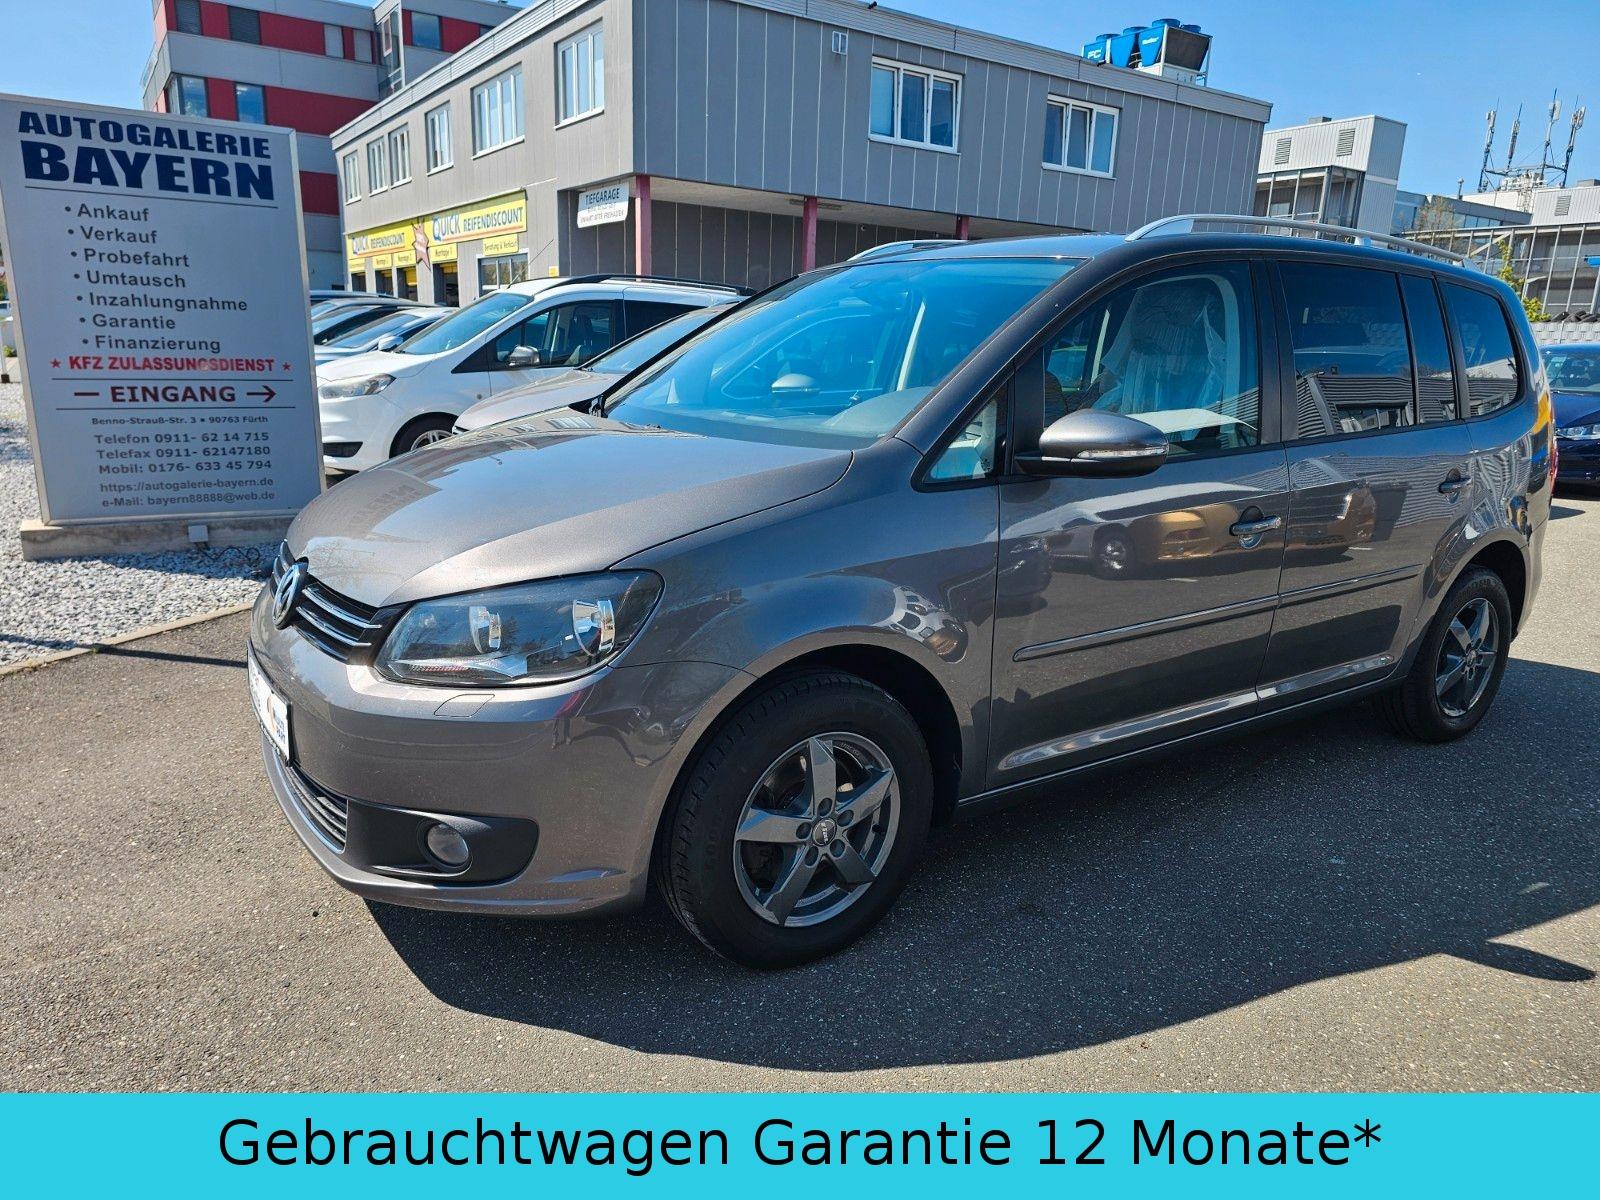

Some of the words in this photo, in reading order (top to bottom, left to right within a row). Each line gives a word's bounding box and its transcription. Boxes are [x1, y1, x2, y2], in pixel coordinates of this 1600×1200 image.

[18, 111, 271, 159] AUTOGALERIE
[20, 140, 275, 200] BAYERN
[585, 187, 620, 206] TIEFGARAGE
[77, 203, 150, 222] Ankauf
[432, 214, 461, 241] QUICK
[463, 206, 524, 232] REIFENDISCOUNT
[80, 226, 158, 244] Verkauf
[352, 235, 370, 256] QUICK
[84, 249, 190, 268] Probefahrt
[86, 270, 186, 288] Umtausch
[89, 292, 248, 313] Inzahlungnahme
[92, 313, 176, 330] Garantie
[95, 335, 221, 354] Finanzierung
[69, 356, 104, 370] KFZ
[108, 356, 275, 371] ZULASSUNGSDIENST
[110, 385, 237, 403] EINGANG
[91, 417, 188, 425] Benno-Strauß-Str.
[190, 416, 197, 424] 3
[208, 415, 240, 424] 90763
[242, 415, 268, 423] Fürth
[94, 433, 150, 444] Telefon
[154, 433, 197, 443] 0911-
[201, 432, 218, 442] 62
[223, 432, 240, 442] 14
[244, 431, 270, 441] 715
[96, 449, 151, 459] Telefax
[156, 448, 197, 458] 0911-
[202, 446, 271, 457] 62147180
[99, 463, 144, 474] Mobil:
[148, 463, 191, 473] 0176-
[195, 461, 221, 471] 633
[226, 461, 243, 470] 45
[247, 460, 272, 470] 794
[100, 477, 274, 493] https://autogalerie-bayern.de
[102, 496, 144, 507] e-Mail:
[147, 491, 275, 506] bayern88888@web.de
